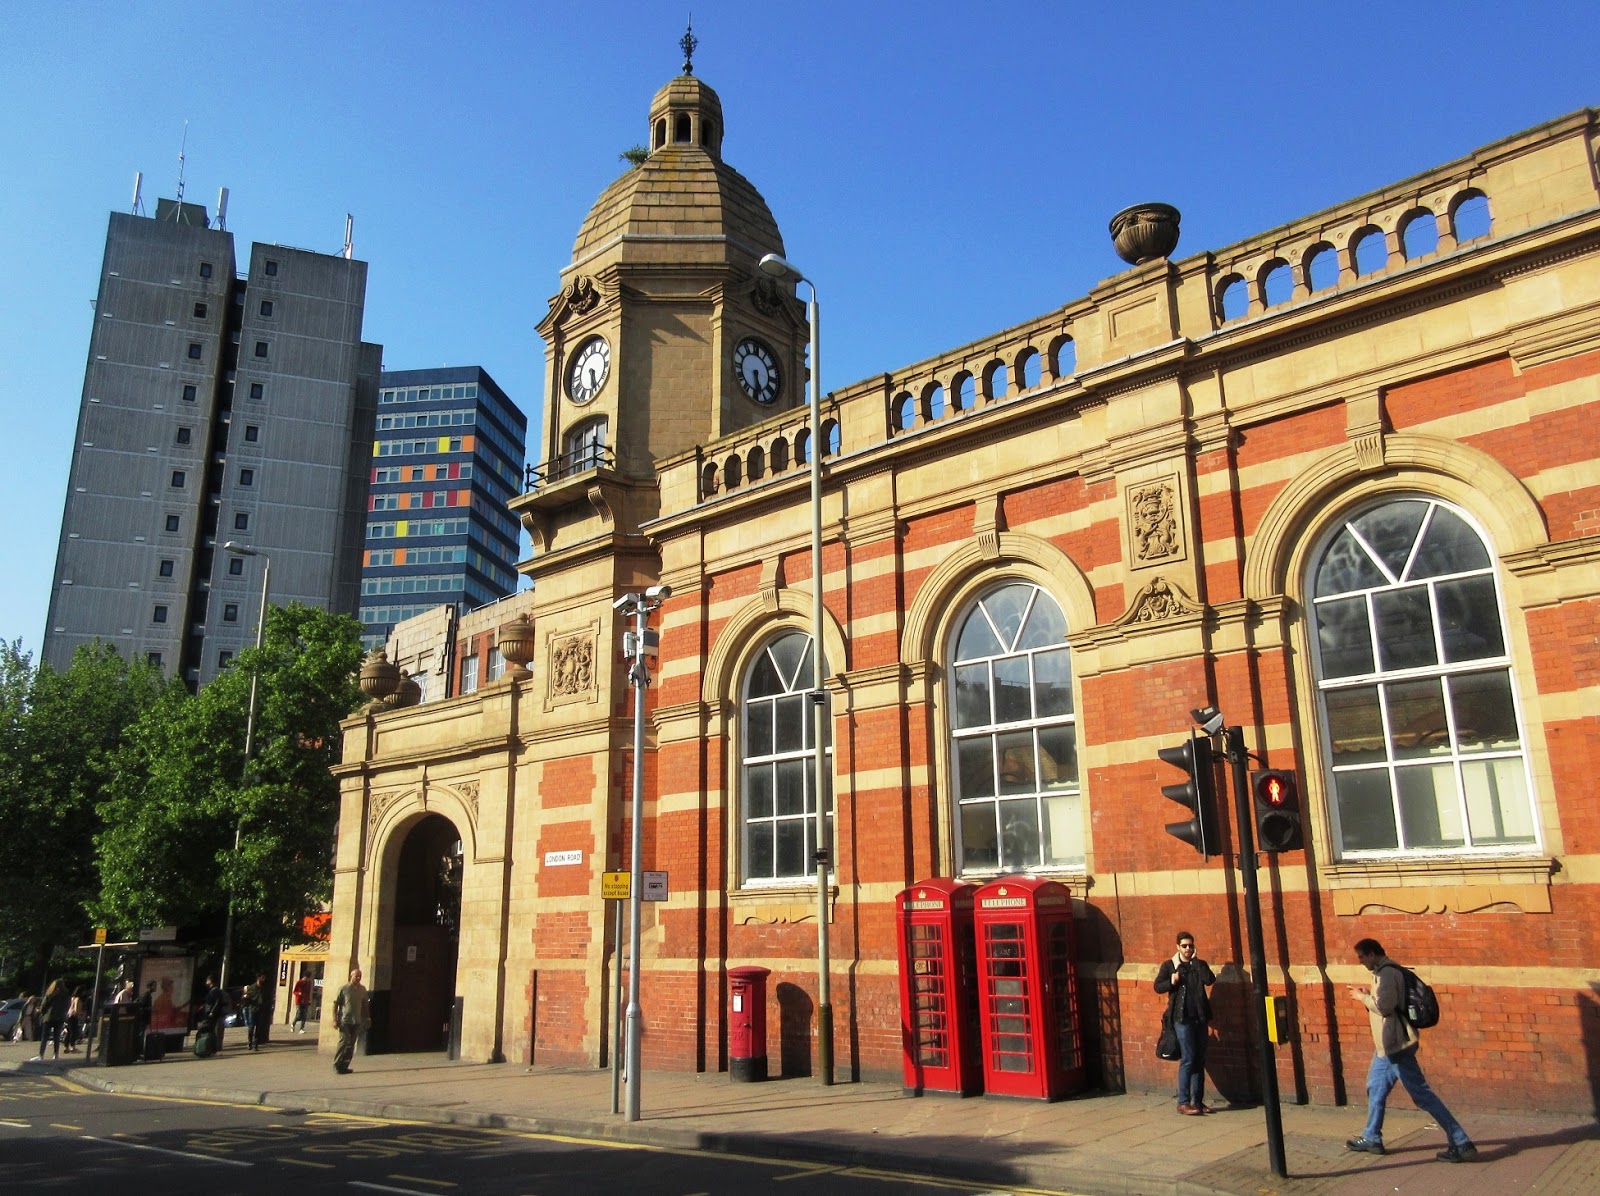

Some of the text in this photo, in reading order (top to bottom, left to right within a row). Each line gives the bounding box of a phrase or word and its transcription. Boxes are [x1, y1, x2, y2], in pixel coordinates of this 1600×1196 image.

[546, 853, 581, 863] LONDON ROAD
[904, 901, 942, 909] TELEPHONE
[983, 899, 1025, 907] TELEPHONE
[302, 1132, 502, 1159] BUS
